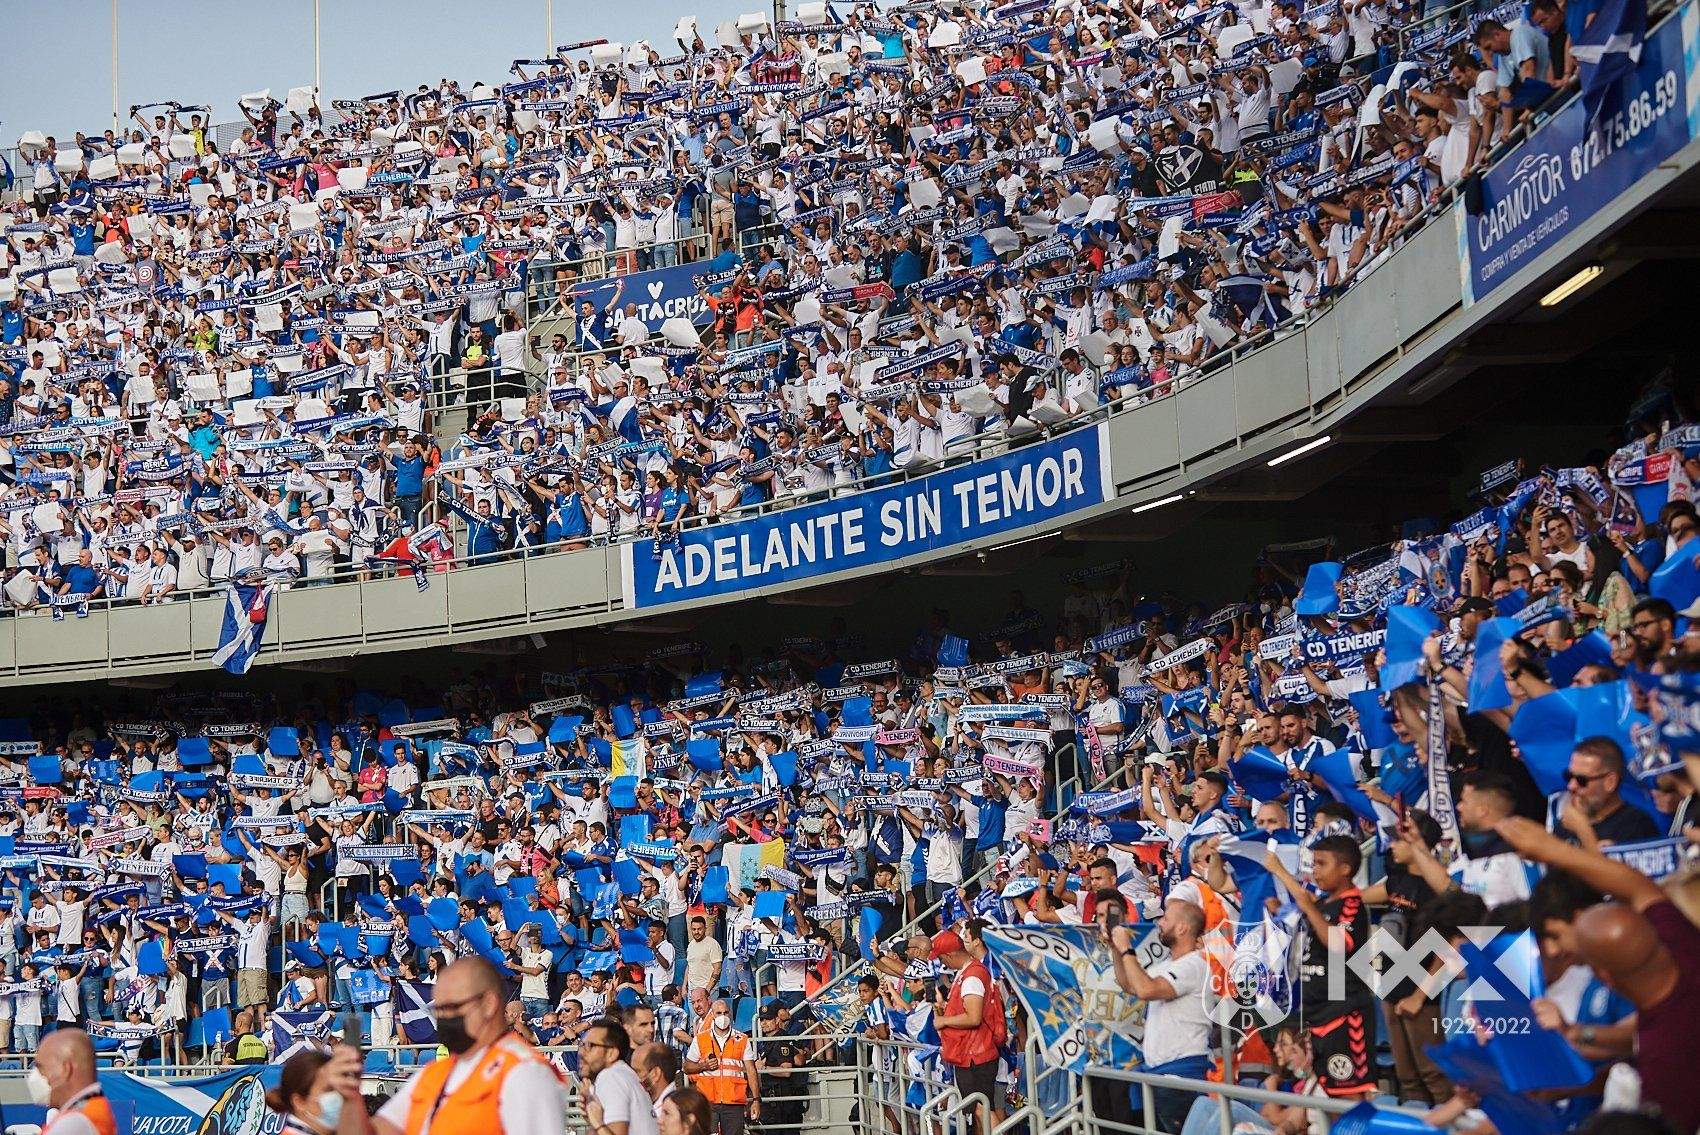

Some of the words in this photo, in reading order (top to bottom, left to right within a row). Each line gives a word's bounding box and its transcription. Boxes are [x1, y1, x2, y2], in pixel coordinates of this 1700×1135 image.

[1261, 140, 1273, 148] CD
[1276, 131, 1312, 144] TENERIFE
[470, 281, 500, 290] TENERIFE
[928, 382, 940, 390] CD
[655, 508, 865, 593] ADELANTE
[881, 490, 942, 547] SIN
[954, 447, 1085, 529] TEMOR
[1098, 632, 1136, 648] TENERIFE
[1308, 640, 1326, 658] CD
[862, 660, 891, 672] TENERIFE
[1006, 658, 1032, 668] TENERIFE
[1040, 694, 1064, 702] TENERIFE
[222, 724, 249, 732] TENERIFE
[958, 766, 981, 776] TENERIFE
[984, 758, 995, 766] CD
[997, 761, 1032, 774] TENERIFE
[192, 937, 228, 946] TENERIFE
